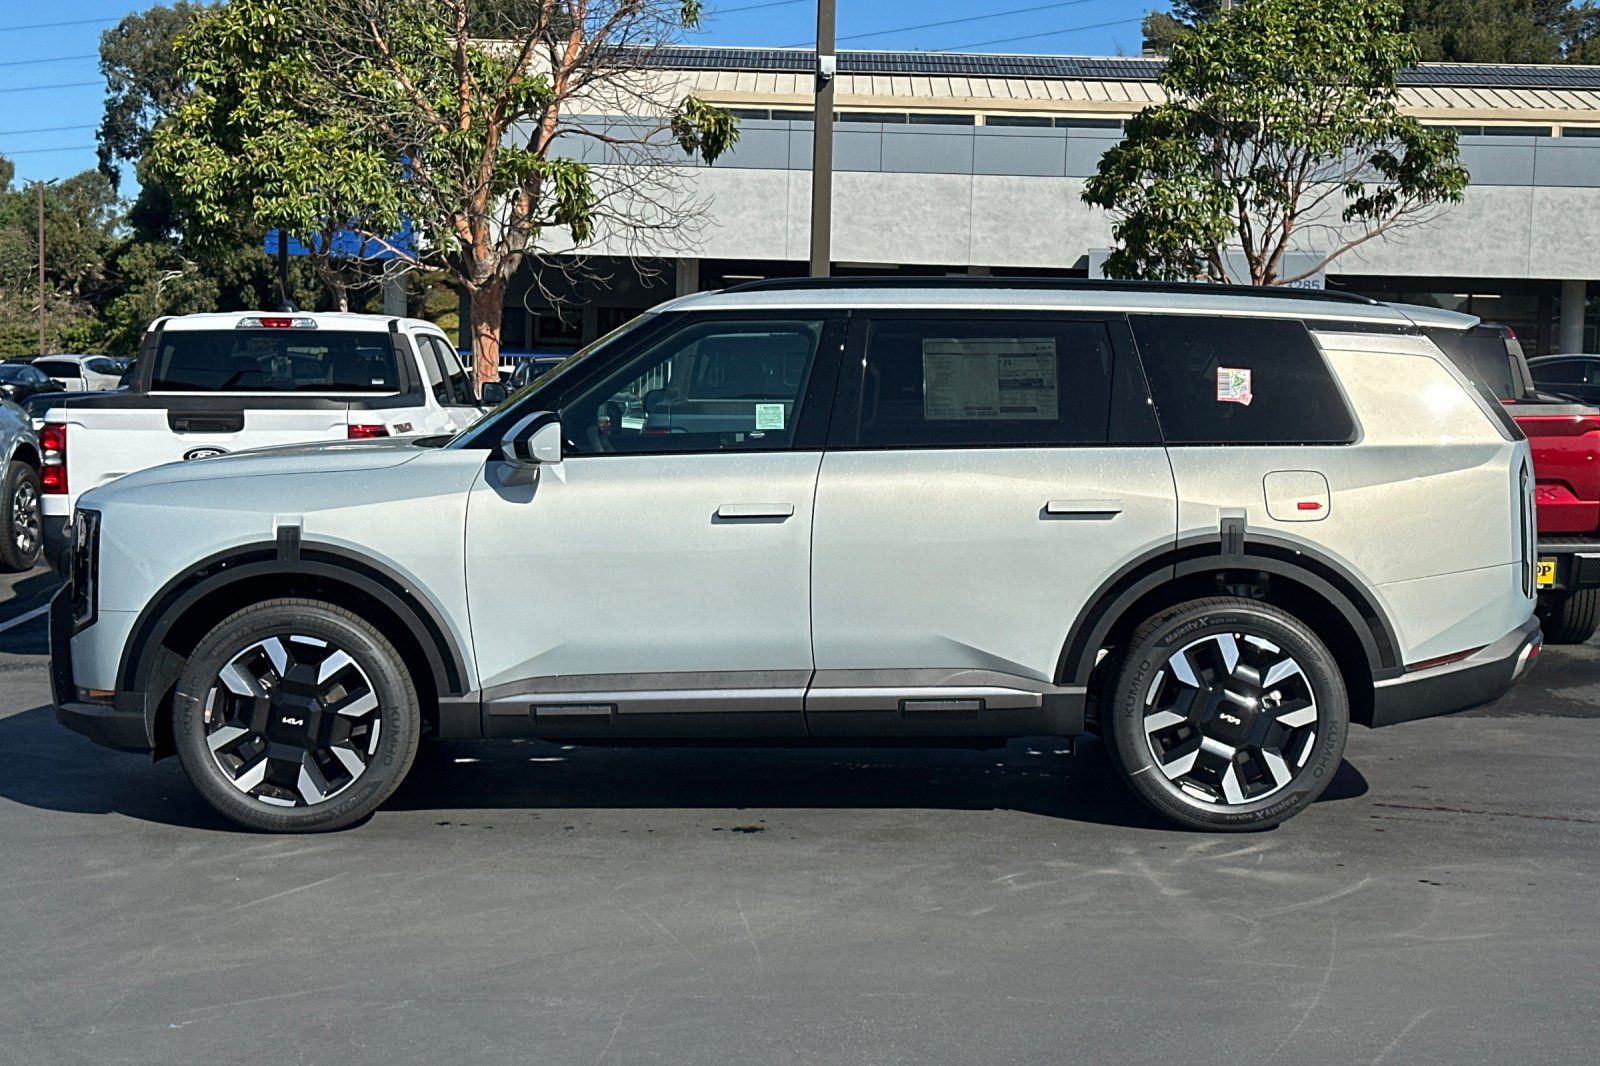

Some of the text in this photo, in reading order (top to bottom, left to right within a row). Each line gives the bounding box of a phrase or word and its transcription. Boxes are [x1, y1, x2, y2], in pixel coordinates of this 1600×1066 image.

[1125, 660, 1151, 718] KUMHO
[382, 705, 400, 767] KUMHO
[1312, 720, 1338, 778] KUMHO
